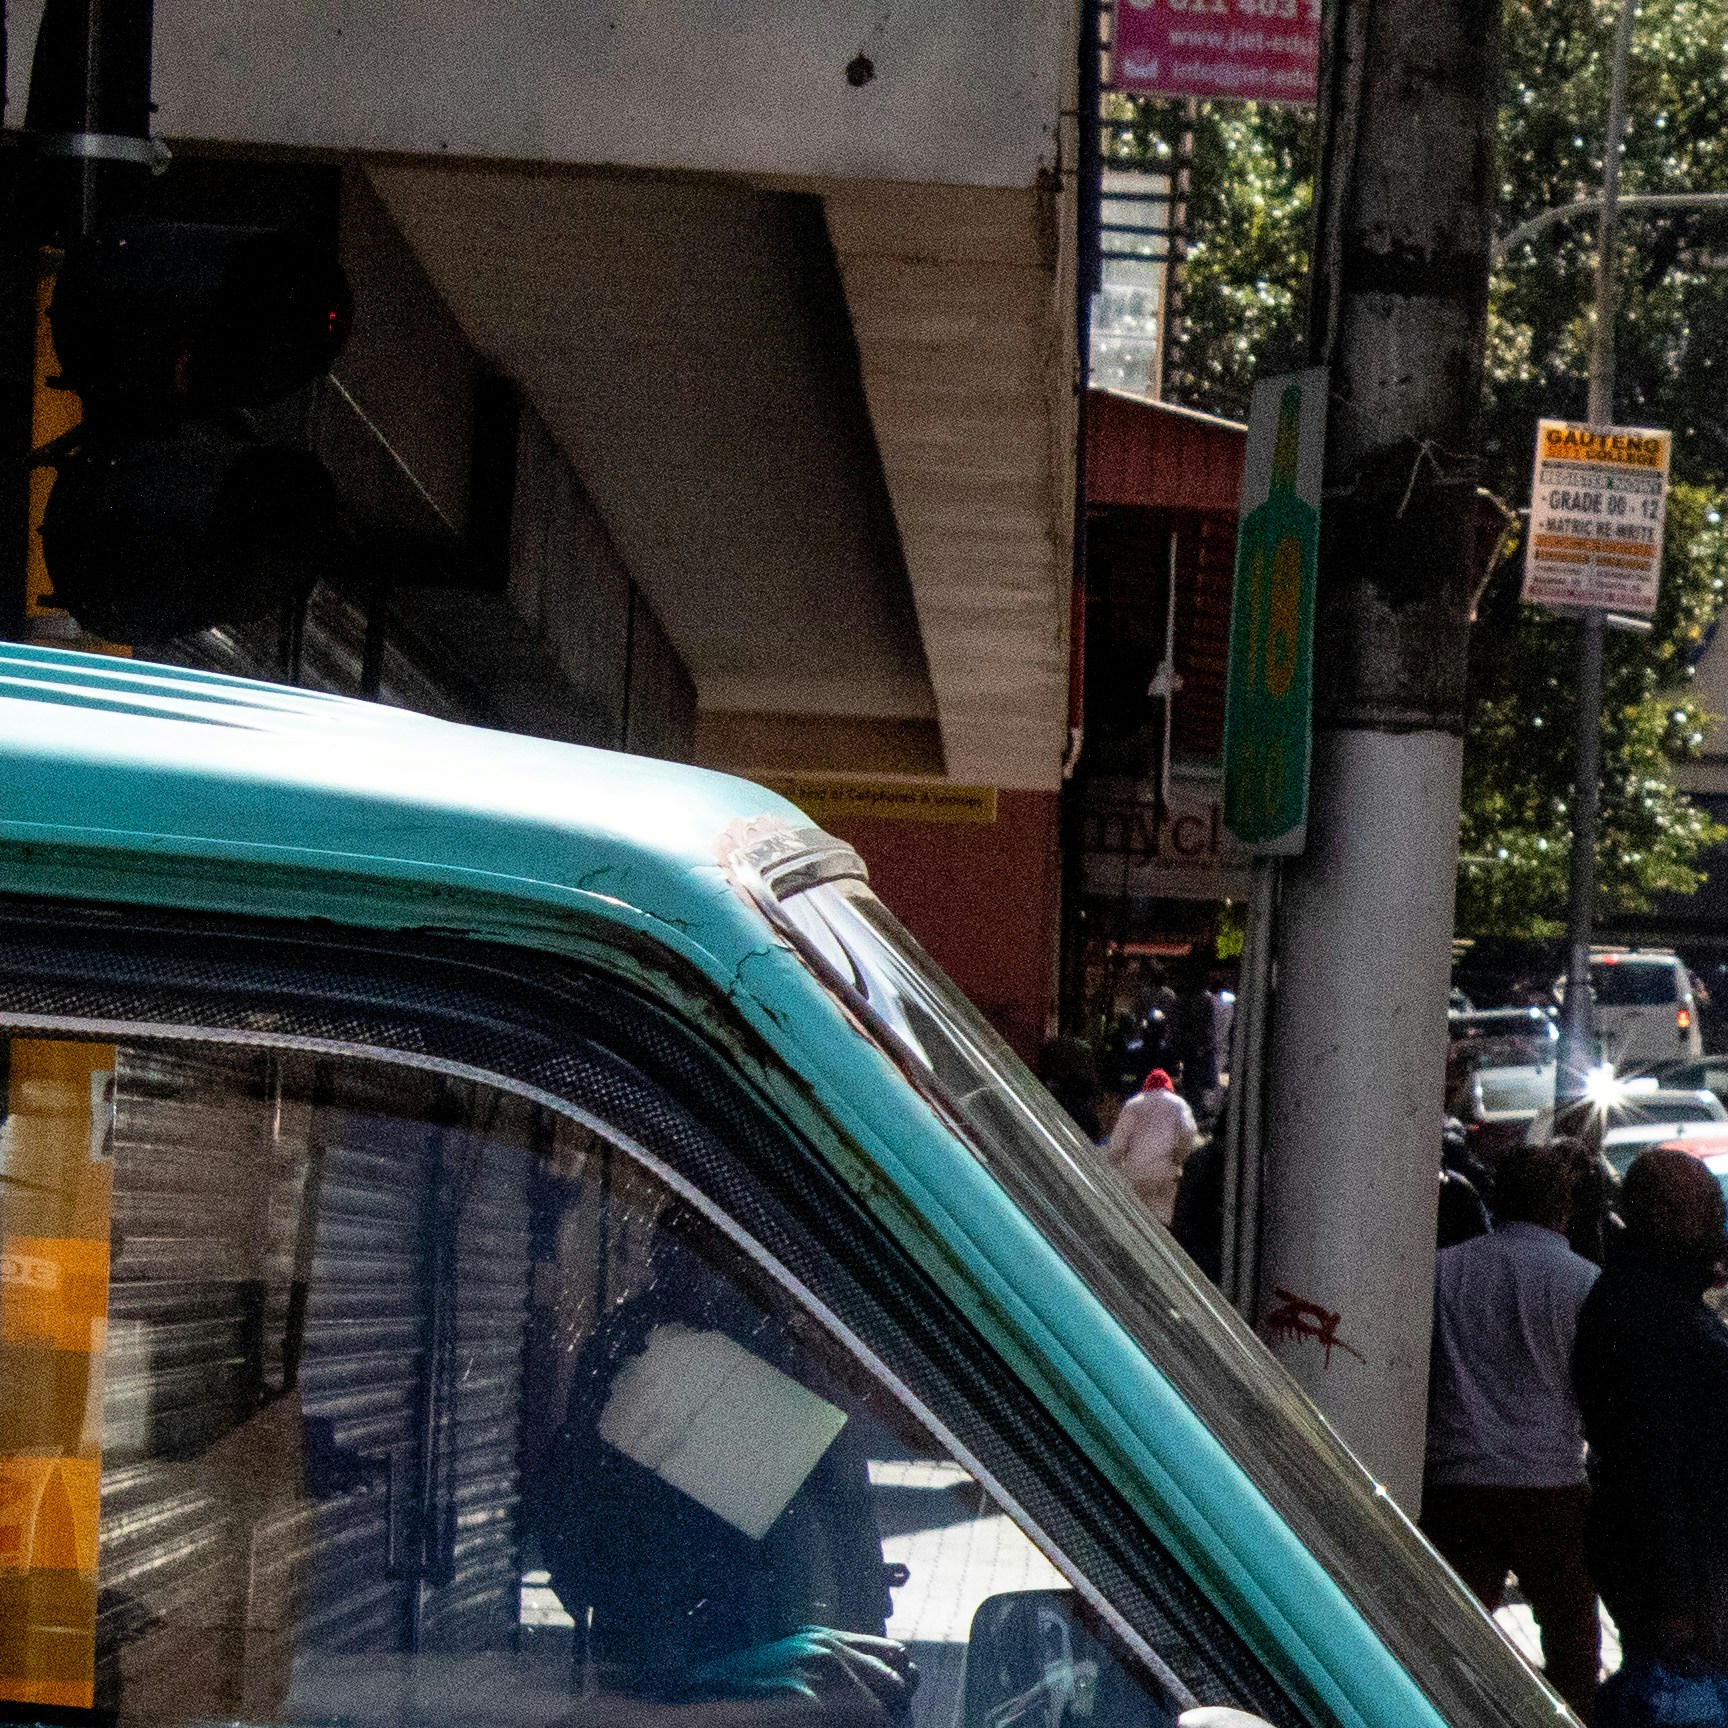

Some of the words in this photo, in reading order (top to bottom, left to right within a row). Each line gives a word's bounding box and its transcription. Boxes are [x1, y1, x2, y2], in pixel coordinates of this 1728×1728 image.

[1546, 429, 1660, 453] GAUTENG
[1549, 490, 1602, 514] GRADE
[1641, 499, 1659, 520] 12
